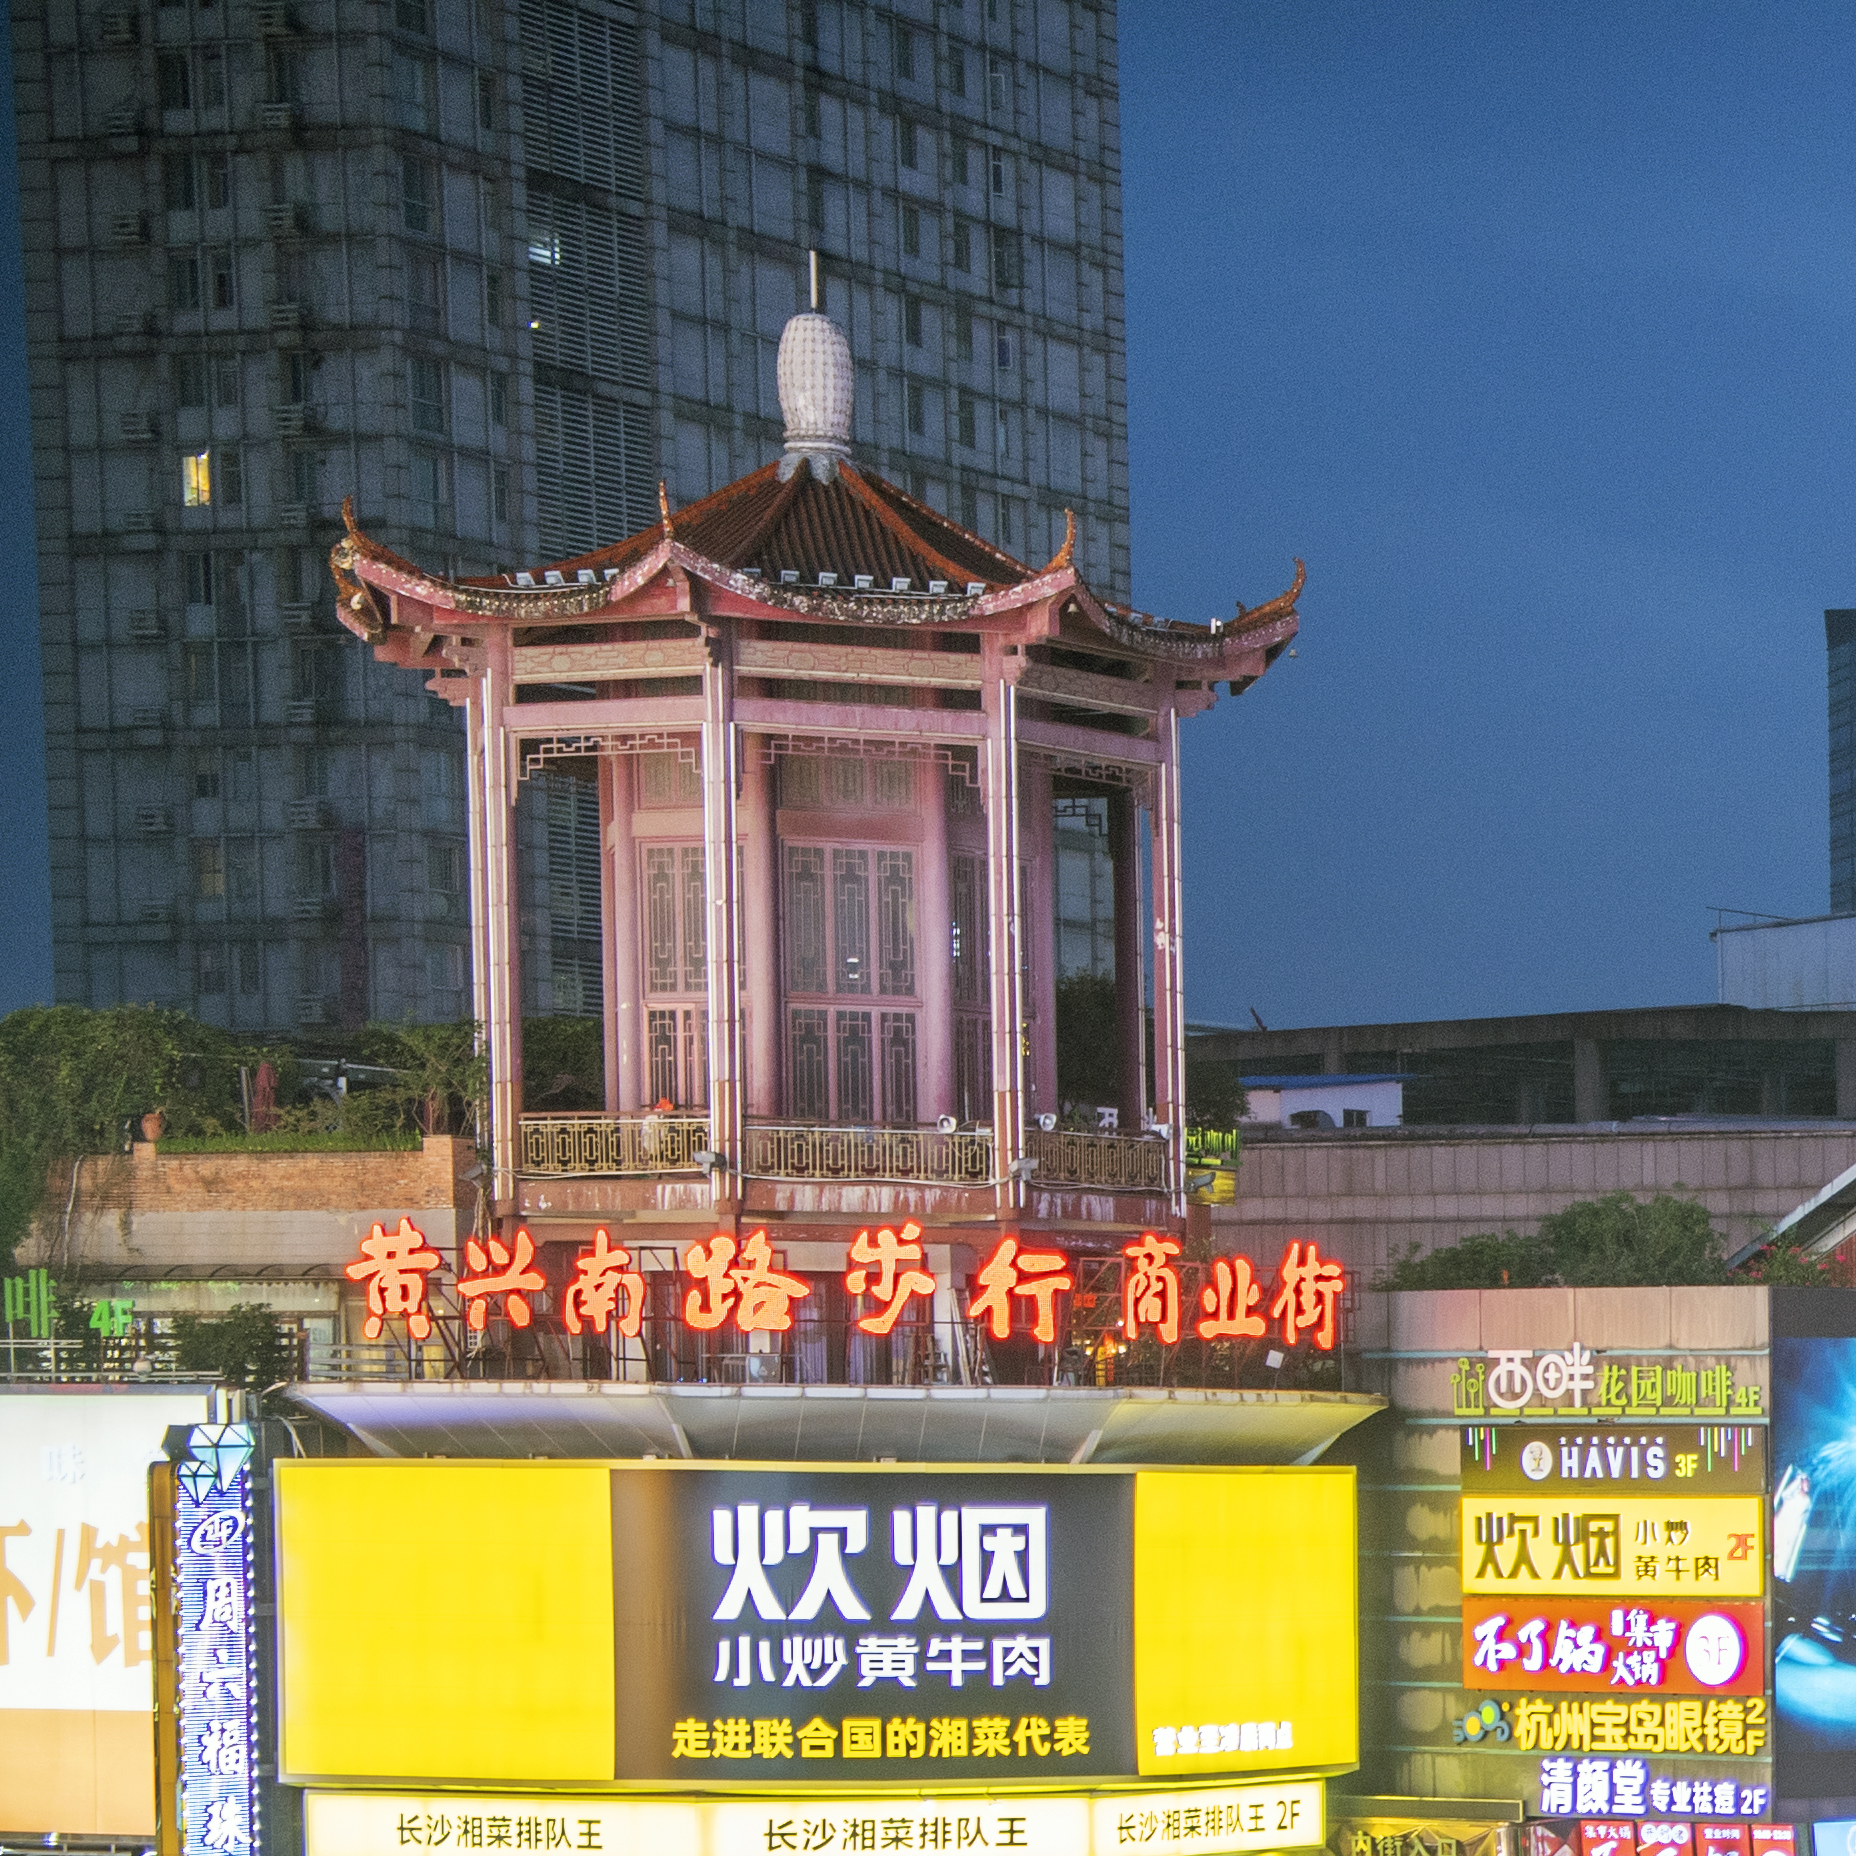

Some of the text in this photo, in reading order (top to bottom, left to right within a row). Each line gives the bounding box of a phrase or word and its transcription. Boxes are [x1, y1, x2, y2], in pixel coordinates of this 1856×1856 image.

[347, 1217, 1345, 1350] 黄兴南路步行商业街
[90, 1300, 134, 1337] 4F
[1597, 1364, 1733, 1407] 花园咖啡
[1735, 1386, 1761, 1407] 4F
[1560, 1447, 1698, 1478] HAVIS 3F
[712, 1504, 1048, 1620] 炊烟
[1474, 1512, 1622, 1579] 炊烟
[1635, 1519, 1691, 1546] 小炒
[1634, 1555, 1721, 1580] 黄牛肉
[714, 1636, 1051, 1687] 小炒黄牛肉
[1473, 1613, 1607, 1674] 不了锅
[1611, 1651, 1660, 1686] 火锅
[672, 1717, 1090, 1759] 走进联合国的湘菜代表
[1514, 1698, 1746, 1755] 杭州宝岛眼镜
[1541, 1758, 1767, 1815] 清颜堂 专业祛痘 2F
[398, 1814, 603, 1850] 长沙湘菜排队王
[765, 1816, 1028, 1851] 长沙湘菜排队王
[1117, 1799, 1301, 1844] 长沙湘菜排队王 2F
